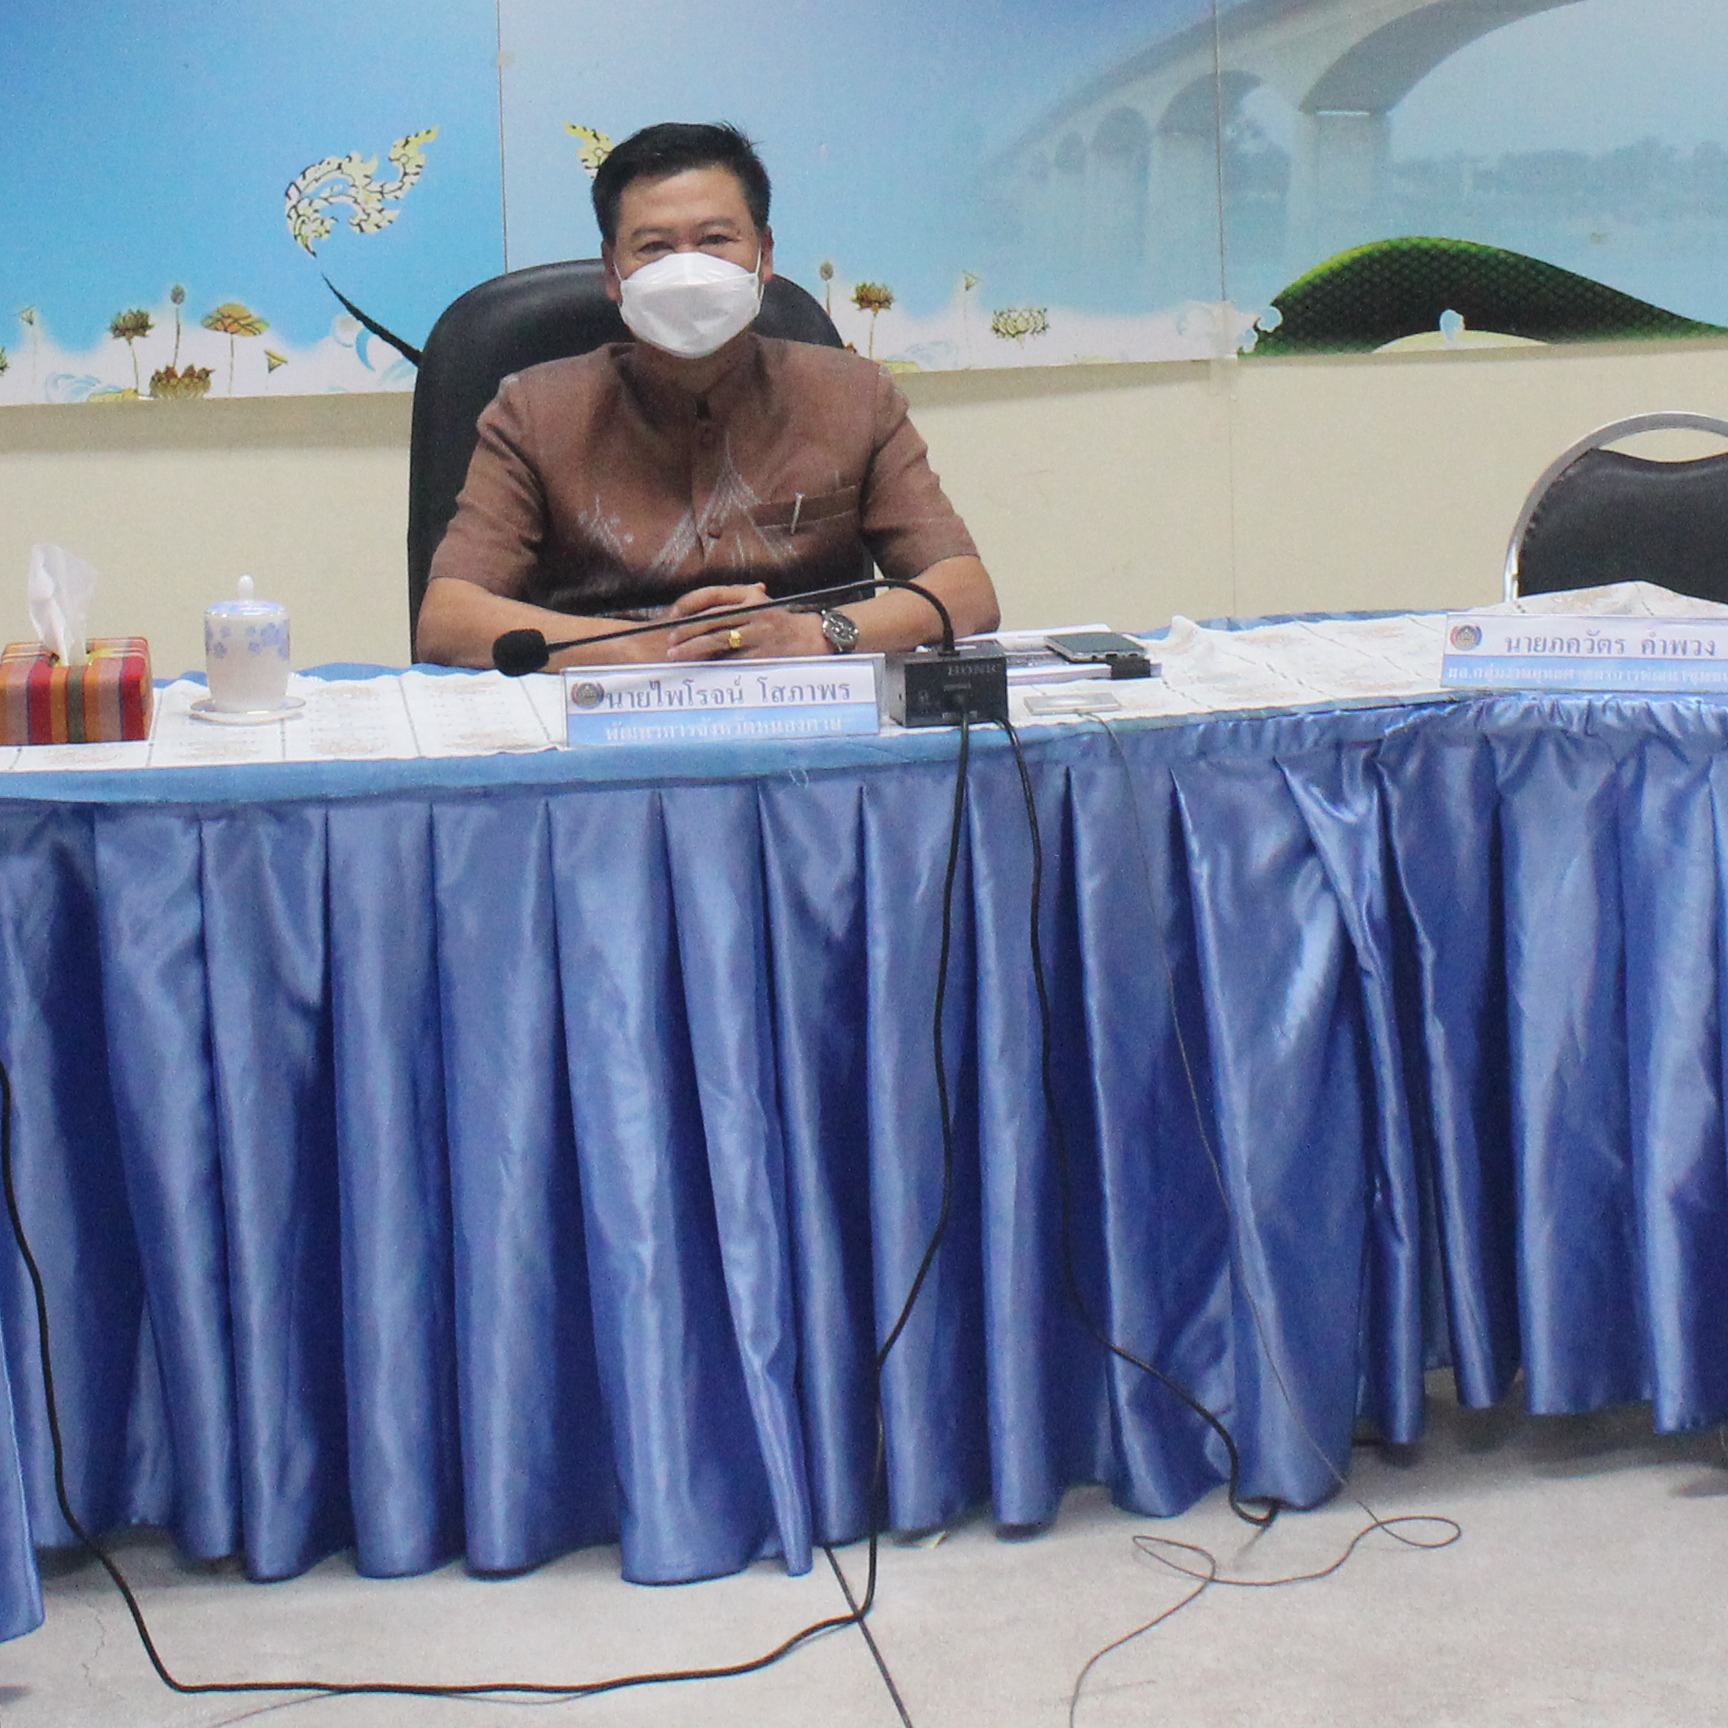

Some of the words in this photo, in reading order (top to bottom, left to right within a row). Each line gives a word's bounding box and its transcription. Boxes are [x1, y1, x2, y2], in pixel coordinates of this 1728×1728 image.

[1504, 628, 1627, 656] นายภควัตร
[1640, 632, 1717, 658] คำพวง
[605, 674, 745, 710] นายไพโรจน์
[756, 676, 852, 703] โสภาพร
